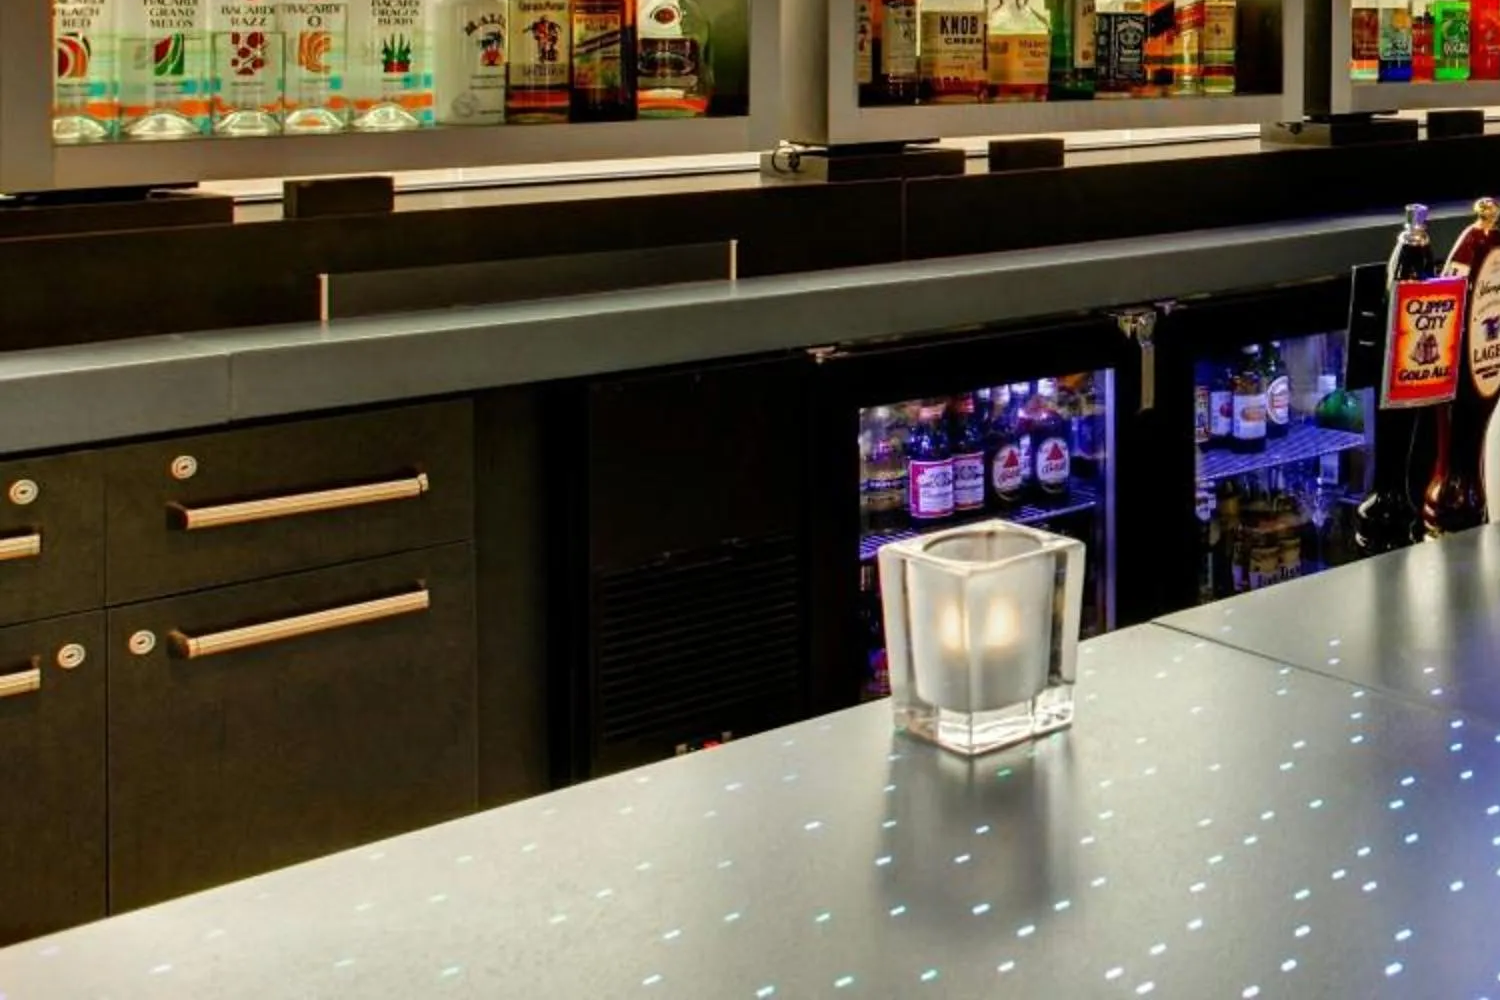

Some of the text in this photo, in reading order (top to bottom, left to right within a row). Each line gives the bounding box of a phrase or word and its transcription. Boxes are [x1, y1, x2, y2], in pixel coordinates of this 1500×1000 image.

[149, 7, 195, 17] GRAND
[221, 5, 275, 16] BACARDI
[287, 4, 340, 15] BACARDI
[230, 16, 267, 27] RAZZ
[307, 15, 322, 27] O
[465, 13, 506, 37] MALI
[939, 15, 979, 35] KNOB
[1415, 315, 1447, 331] CITY
[1398, 368, 1431, 381] GOLD
